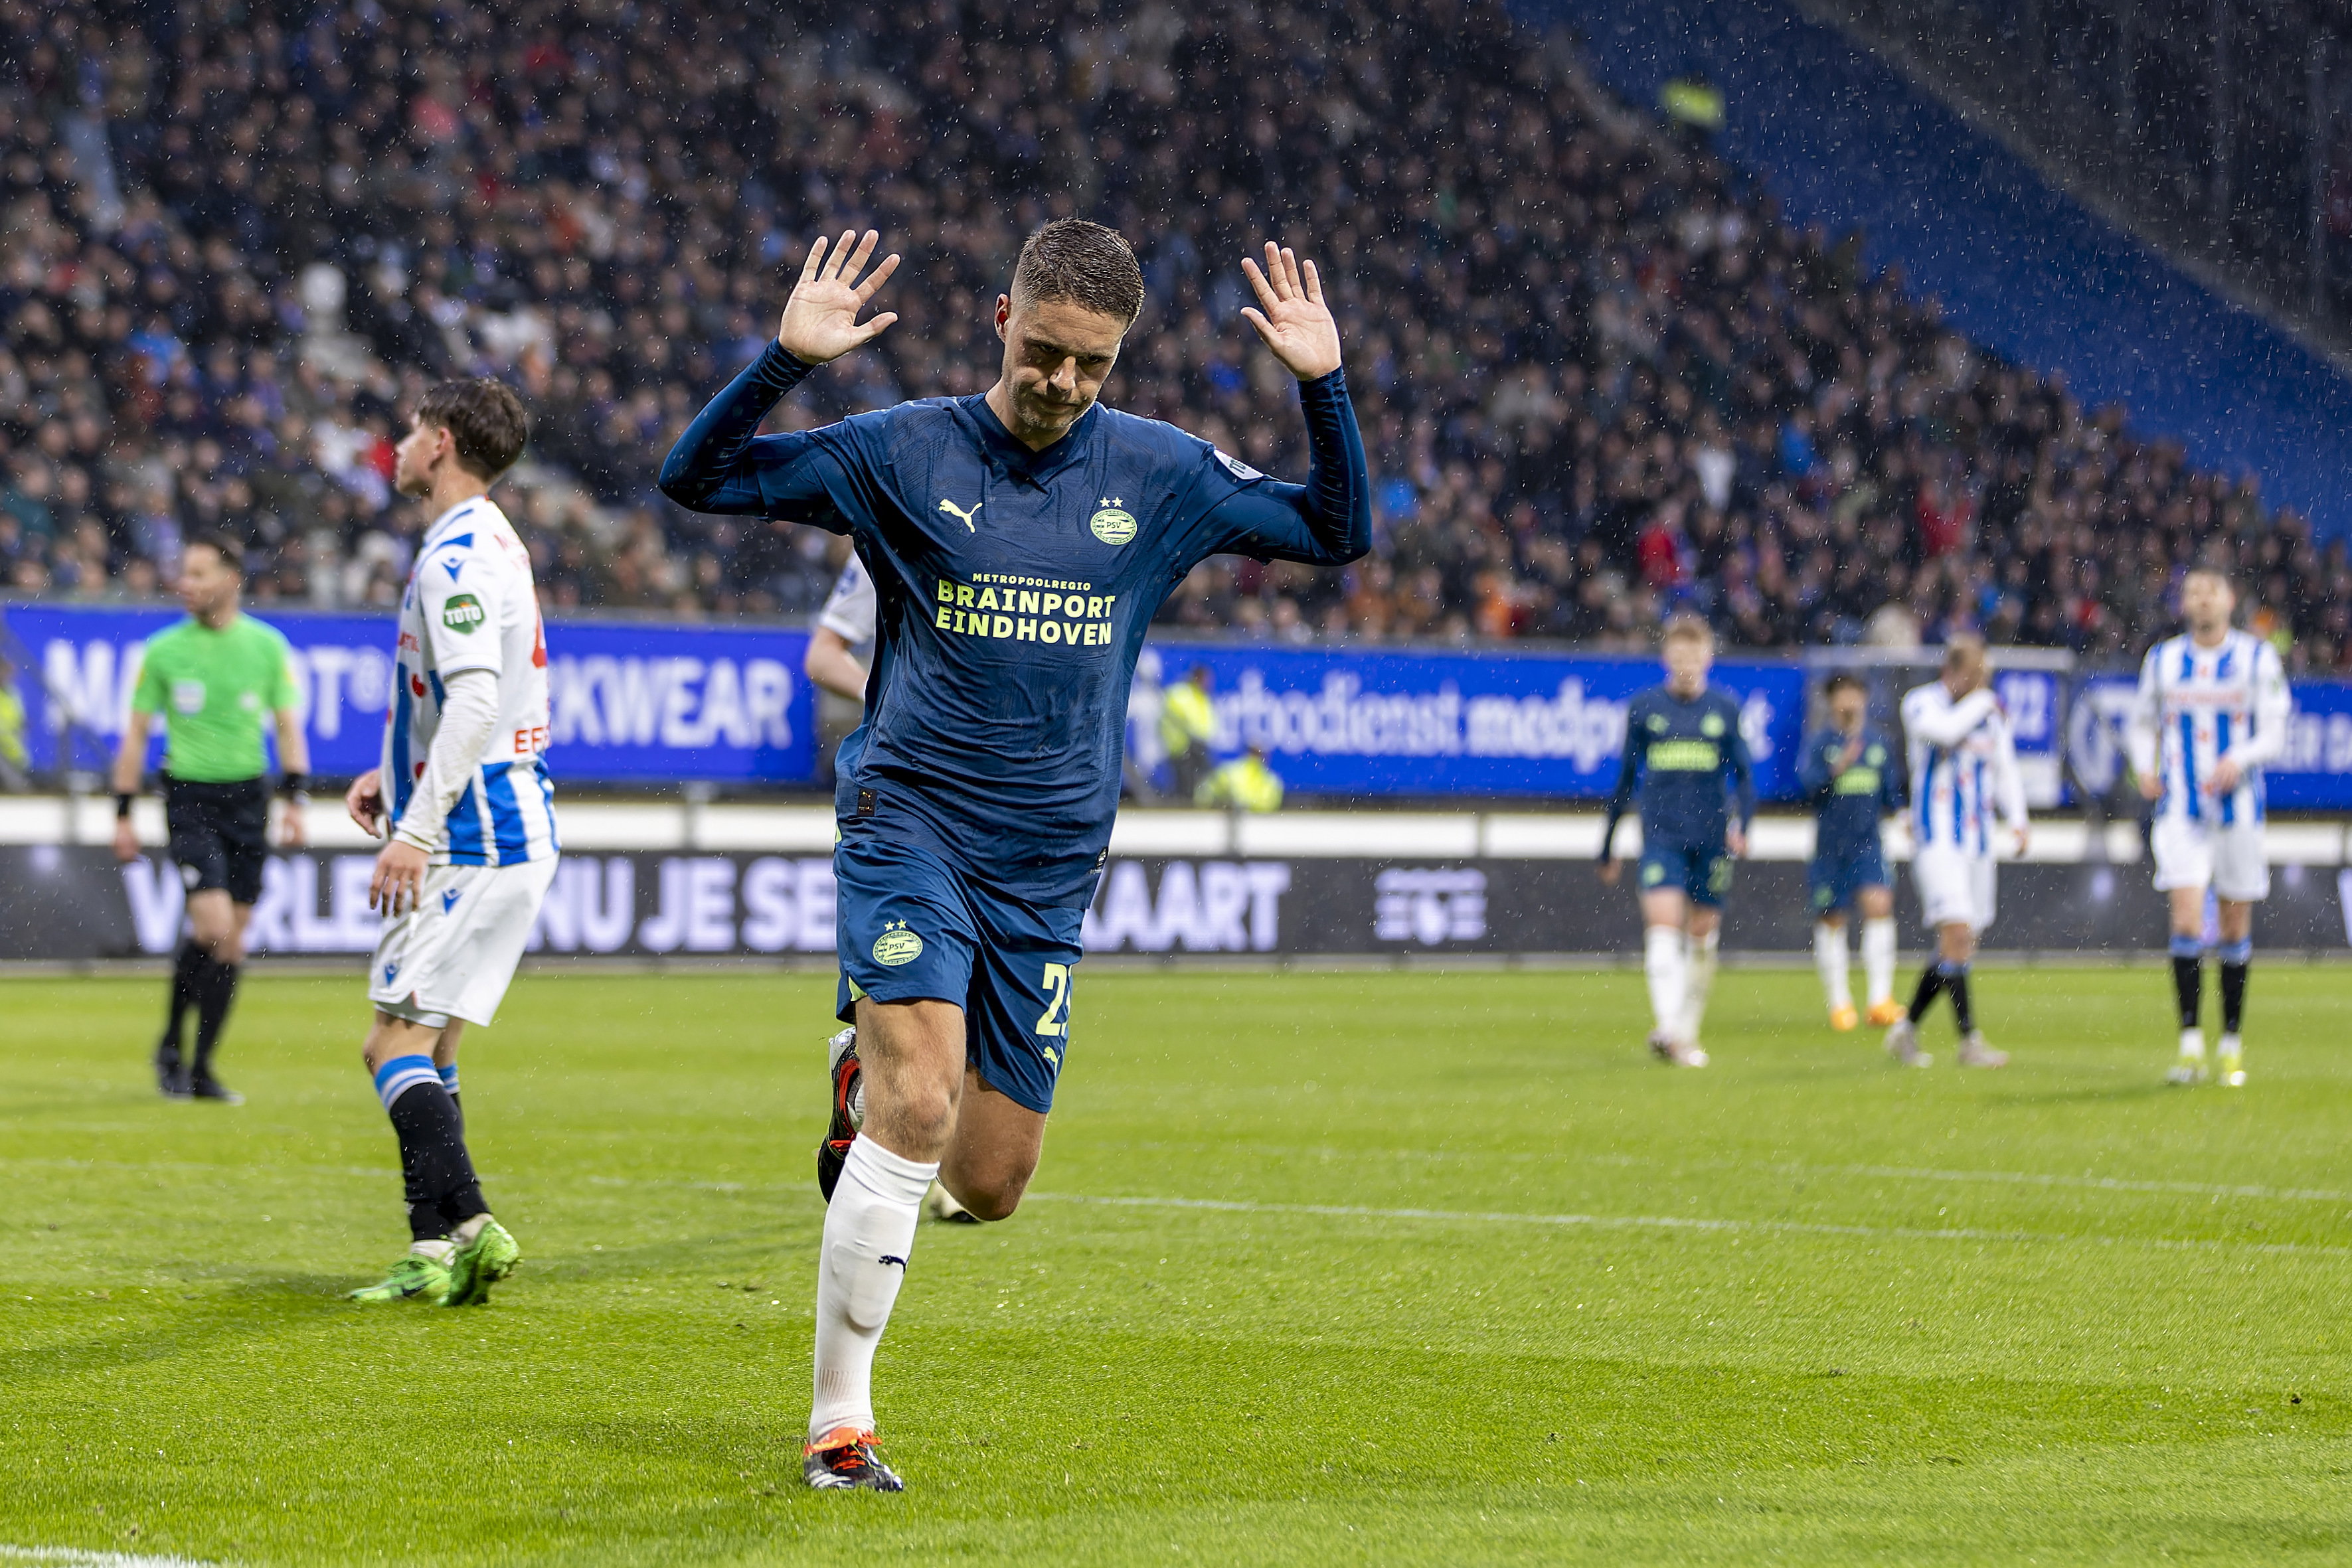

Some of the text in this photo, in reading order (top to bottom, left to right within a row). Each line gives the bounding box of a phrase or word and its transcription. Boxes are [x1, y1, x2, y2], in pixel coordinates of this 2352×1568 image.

[938, 578, 1116, 619] BRAINPORT
[972, 573, 1092, 591] METROPOOLREGIO
[445, 605, 482, 625] TOTO
[936, 605, 1113, 646] EINDHOVEN
[548, 653, 794, 750] KWEAR
[515, 725, 552, 753] EF
[644, 856, 737, 953] JE
[888, 943, 906, 951] PSV
